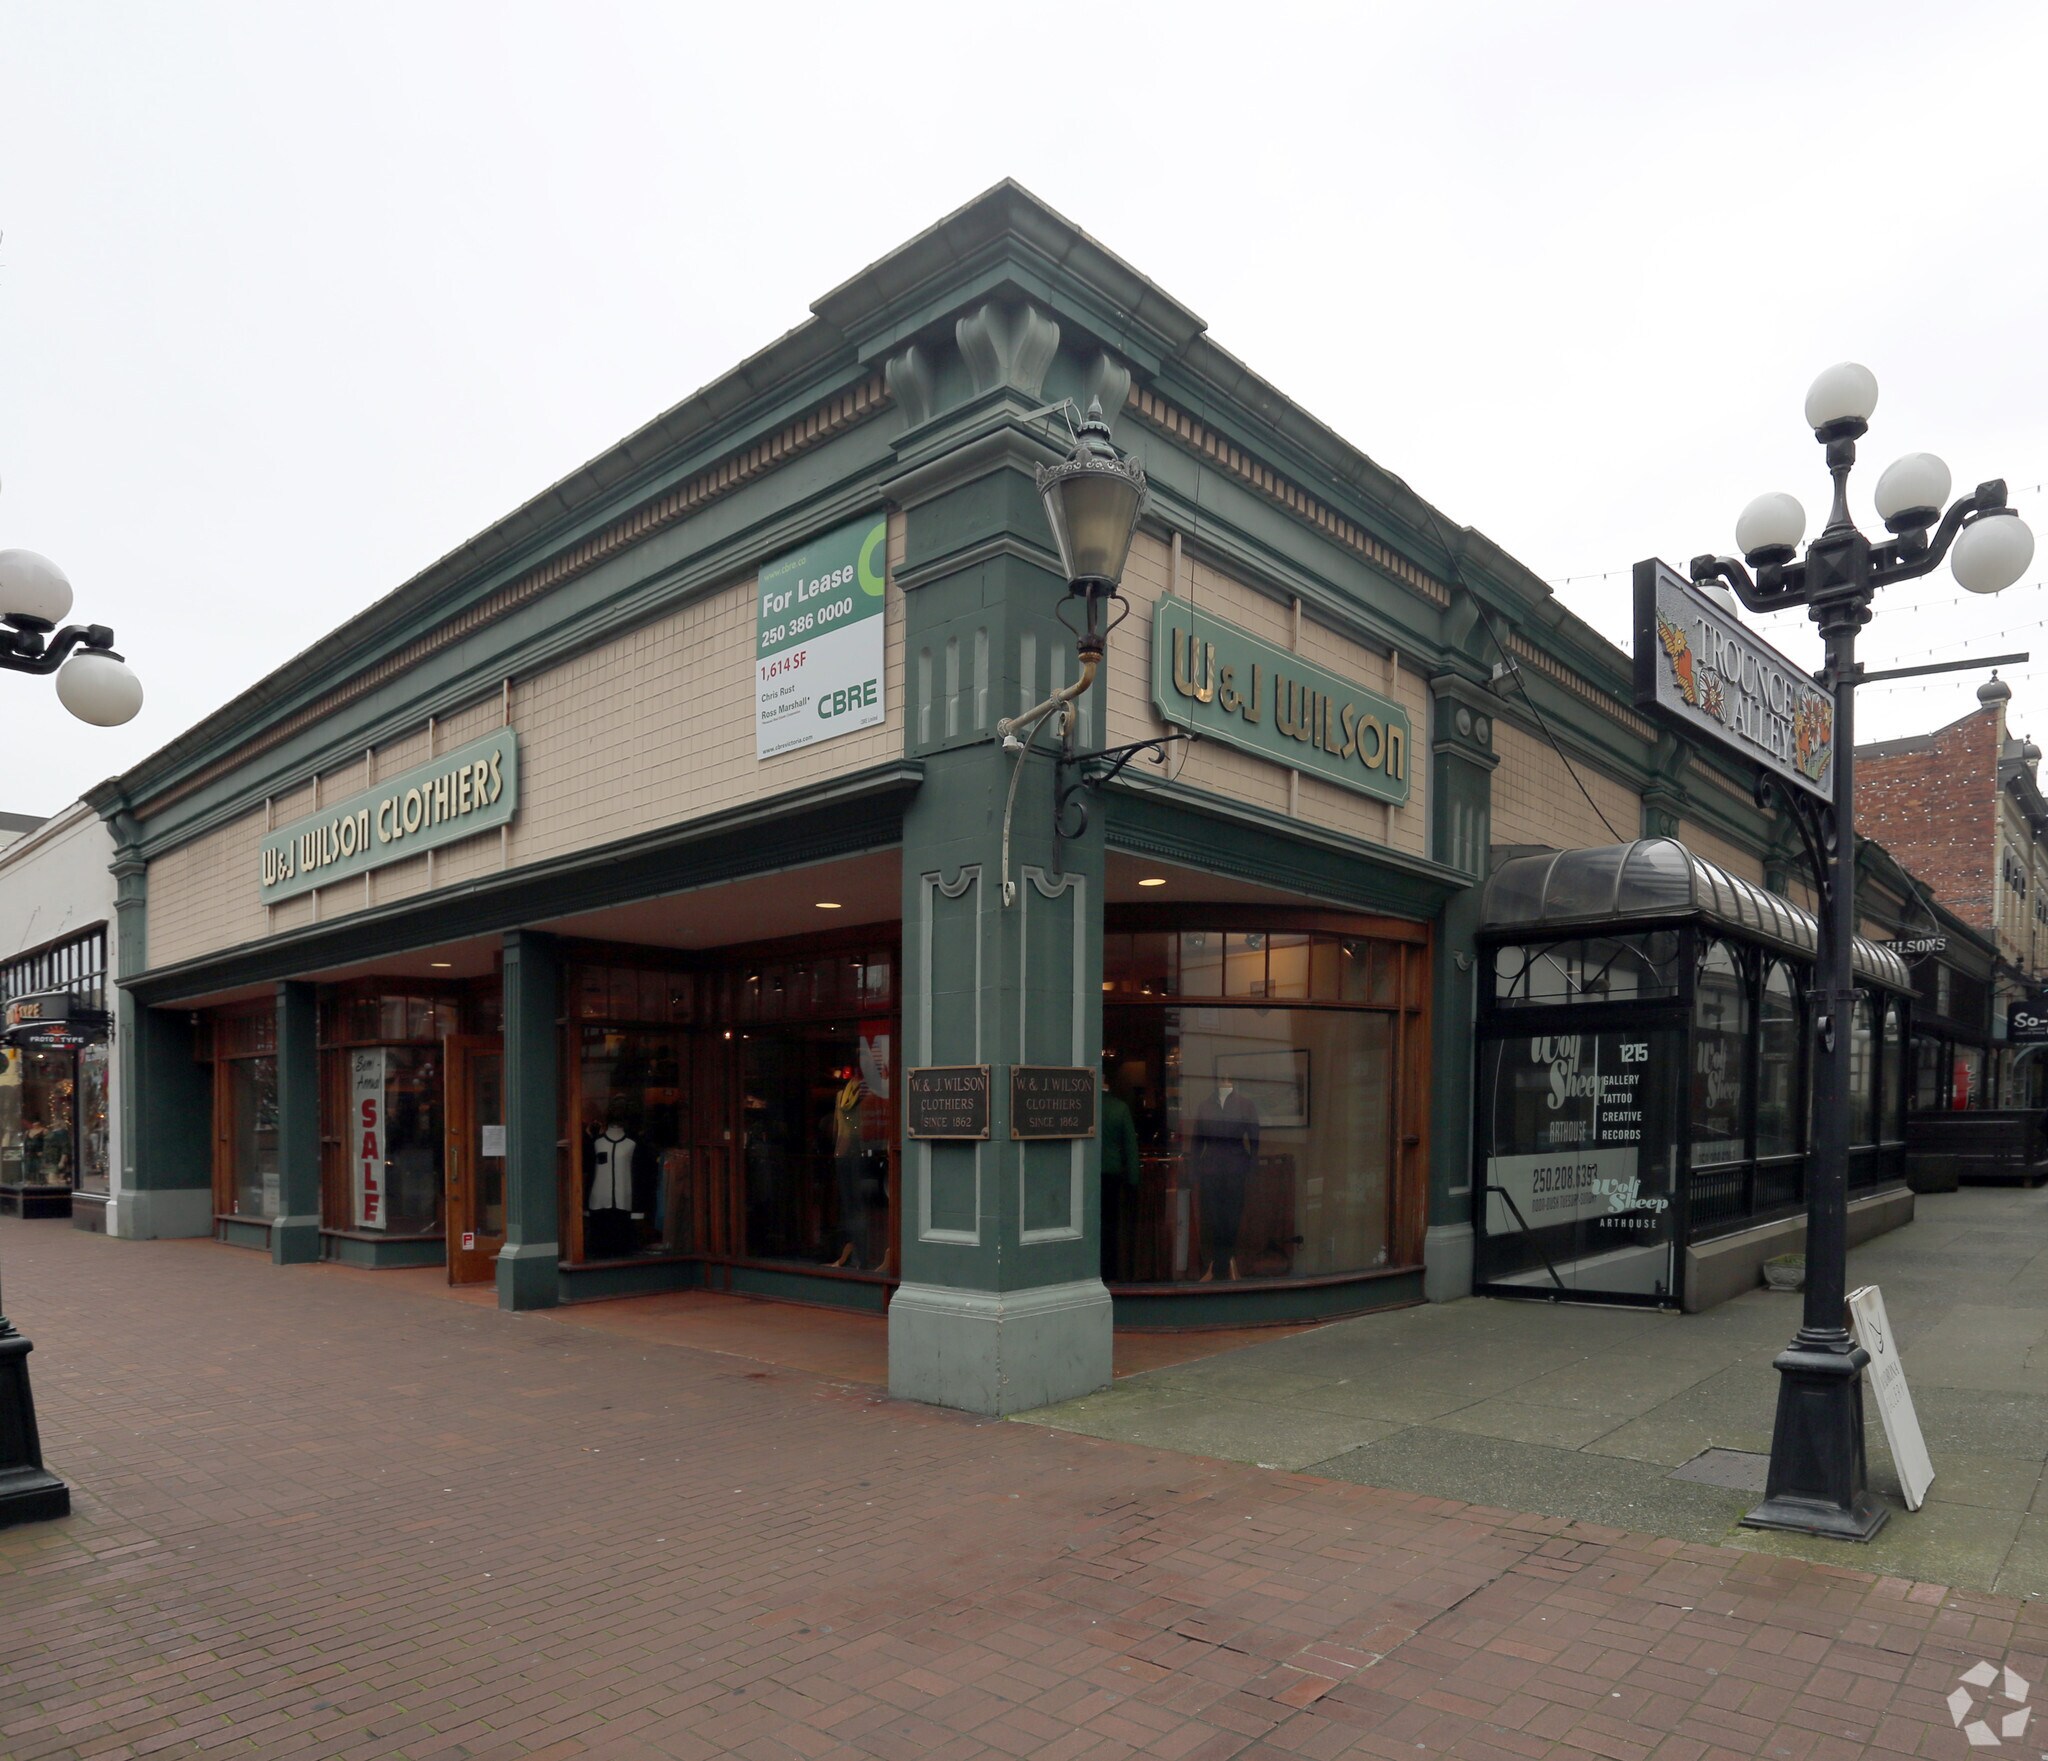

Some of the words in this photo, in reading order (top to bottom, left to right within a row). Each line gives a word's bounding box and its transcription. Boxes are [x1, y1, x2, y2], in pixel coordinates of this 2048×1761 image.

[762, 588, 792, 618] For
[798, 564, 854, 603] Lease
[761, 625, 785, 648] 250
[789, 613, 814, 638] 386
[817, 597, 853, 625] 0000
[760, 655, 791, 682] 1,614
[793, 650, 807, 670] SF
[1696, 615, 1794, 722] TROUNCE
[761, 688, 778, 703] Chris
[780, 684, 795, 698] Rust
[817, 678, 877, 720] CBRE
[761, 706, 777, 720] Ross
[1172, 627, 1263, 725] W&J
[1275, 673, 1405, 781] WILSON
[1729, 692, 1793, 761] ALLEY
[762, 734, 813, 755] www.cbrevictoria.com
[262, 839, 296, 887] W&J
[300, 808, 371, 872] WILSON
[377, 750, 504, 843] CLOTHIERS
[1886, 938, 1946, 954] ILSONS
[1619, 1043, 1648, 1062] 1215
[922, 1079, 931, 1092] &
[944, 1076, 985, 1092] WILSON
[1028, 1078, 1038, 1091] &
[1052, 1078, 1092, 1093] WILSON
[1603, 1075, 1640, 1086] GALLERY
[921, 1098, 974, 1111] CLOTHIERS
[1026, 1098, 1082, 1111] CLOTHIERS
[1603, 1093, 1633, 1104] TATTOO
[924, 1117, 948, 1128] SINCE
[952, 1117, 972, 1128] 1862
[1029, 1117, 1055, 1128] SINCE
[1060, 1117, 1079, 1128] 1862
[1602, 1111, 1642, 1122] CREATIVE
[1550, 1121, 1587, 1143] ARTHOUSE
[1602, 1130, 1641, 1140] RECORDS
[361, 1099, 379, 1222] SALE
[1591, 1175, 1641, 1199] Wolf
[1608, 1192, 1669, 1214] Sheep
[1600, 1218, 1657, 1229] ARTHOUSE
